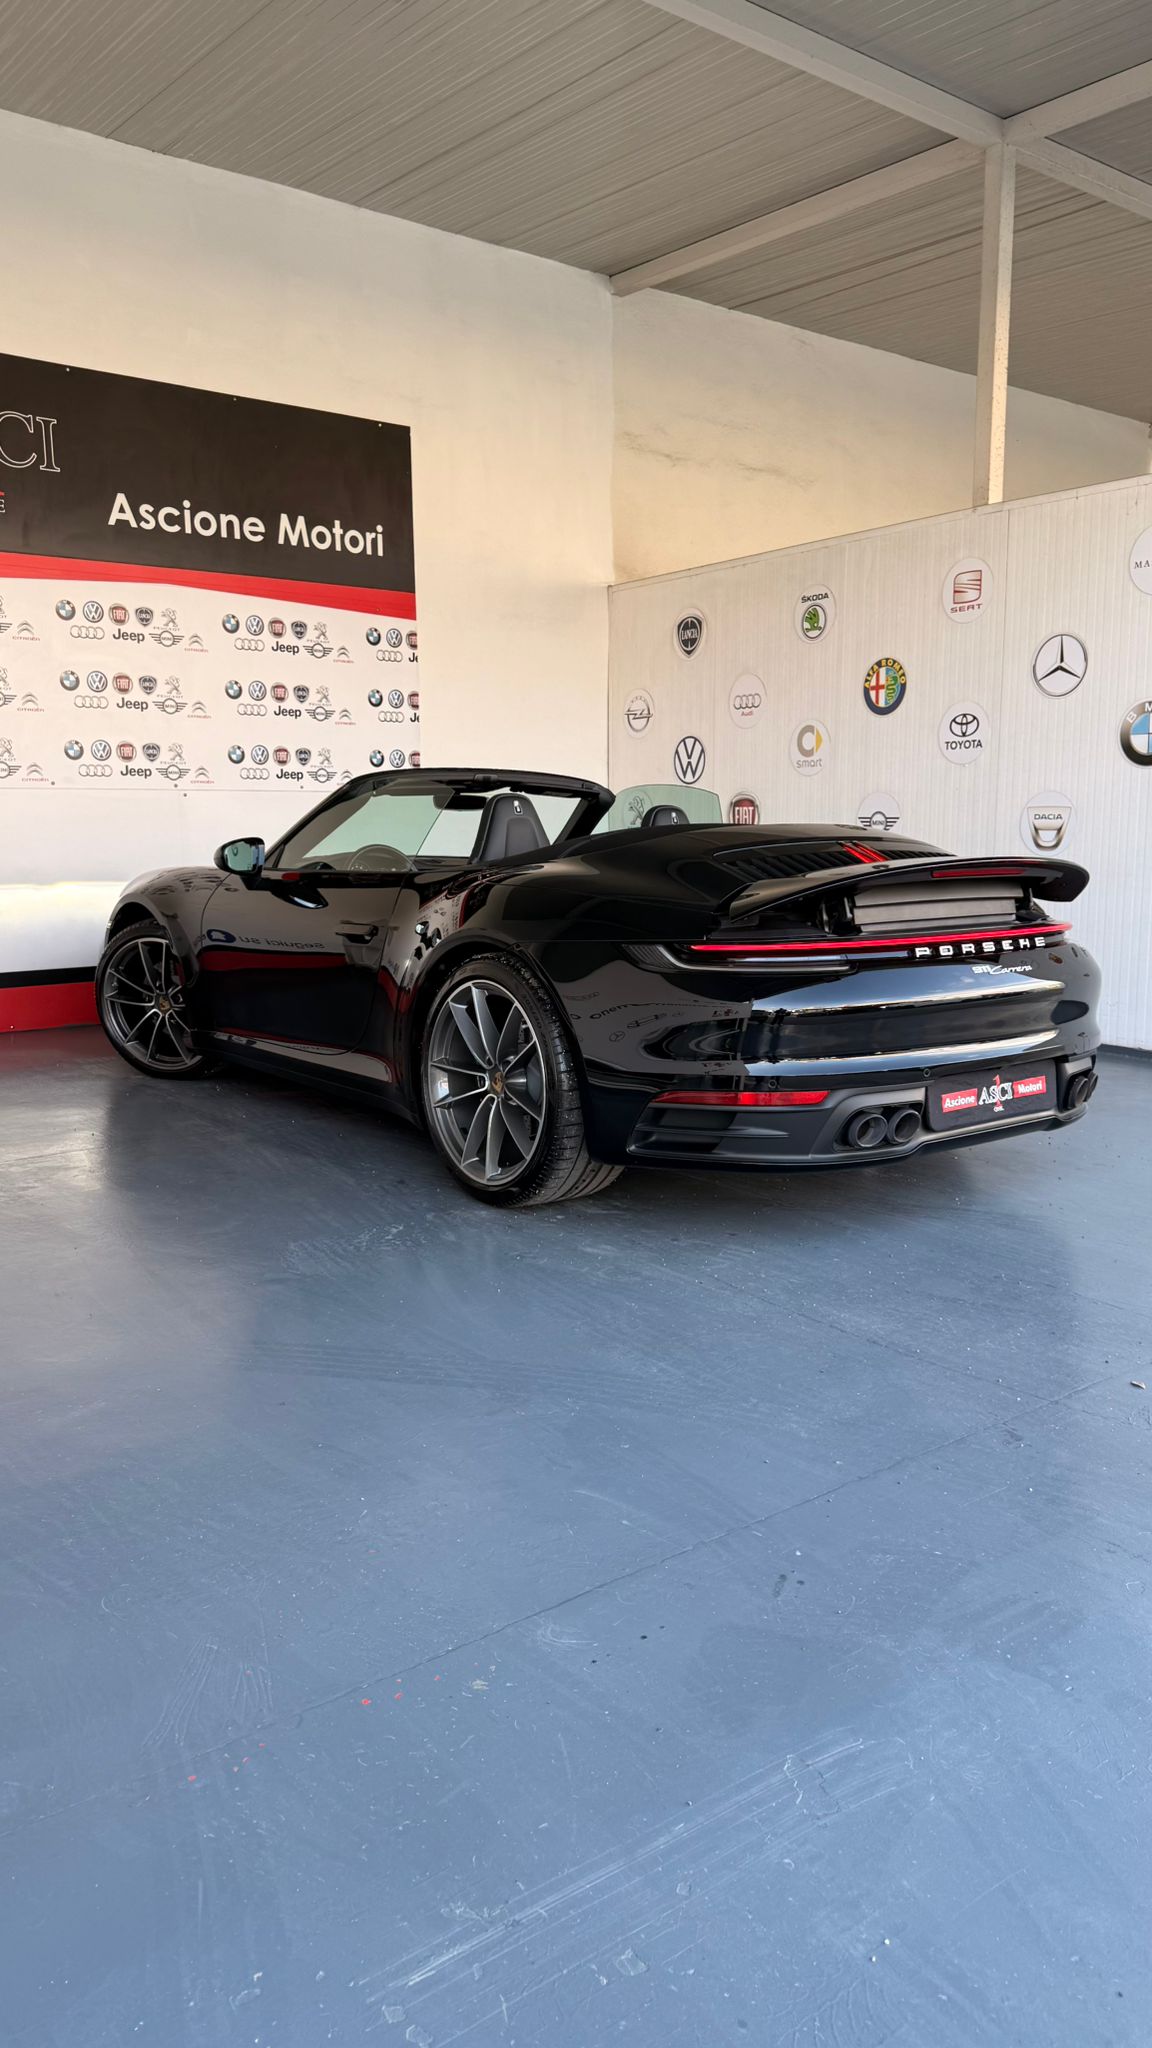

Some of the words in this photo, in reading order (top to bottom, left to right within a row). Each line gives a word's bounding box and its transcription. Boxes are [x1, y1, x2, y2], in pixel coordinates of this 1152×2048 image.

[108, 493, 266, 543] Ascione
[278, 513, 384, 557] Motori
[950, 603, 983, 614] SEAT
[112, 628, 146, 644] Jeep
[271, 641, 300, 656] Jeep
[864, 664, 879, 689] ALFA
[881, 659, 906, 684] ROMEO
[116, 697, 149, 712] Jeep
[273, 705, 302, 719] Jeep
[945, 739, 983, 750] TOYOTA
[796, 758, 822, 769] smart
[120, 765, 153, 779] Jeep
[276, 768, 304, 782] Jeep
[735, 806, 754, 824] FIAT
[1034, 813, 1063, 821] DACIA
[915, 936, 1046, 958] PORSCHE
[990, 965, 1033, 975] Carrera
[944, 1095, 976, 1109] Ascione
[1018, 1080, 1043, 1094] Motori
